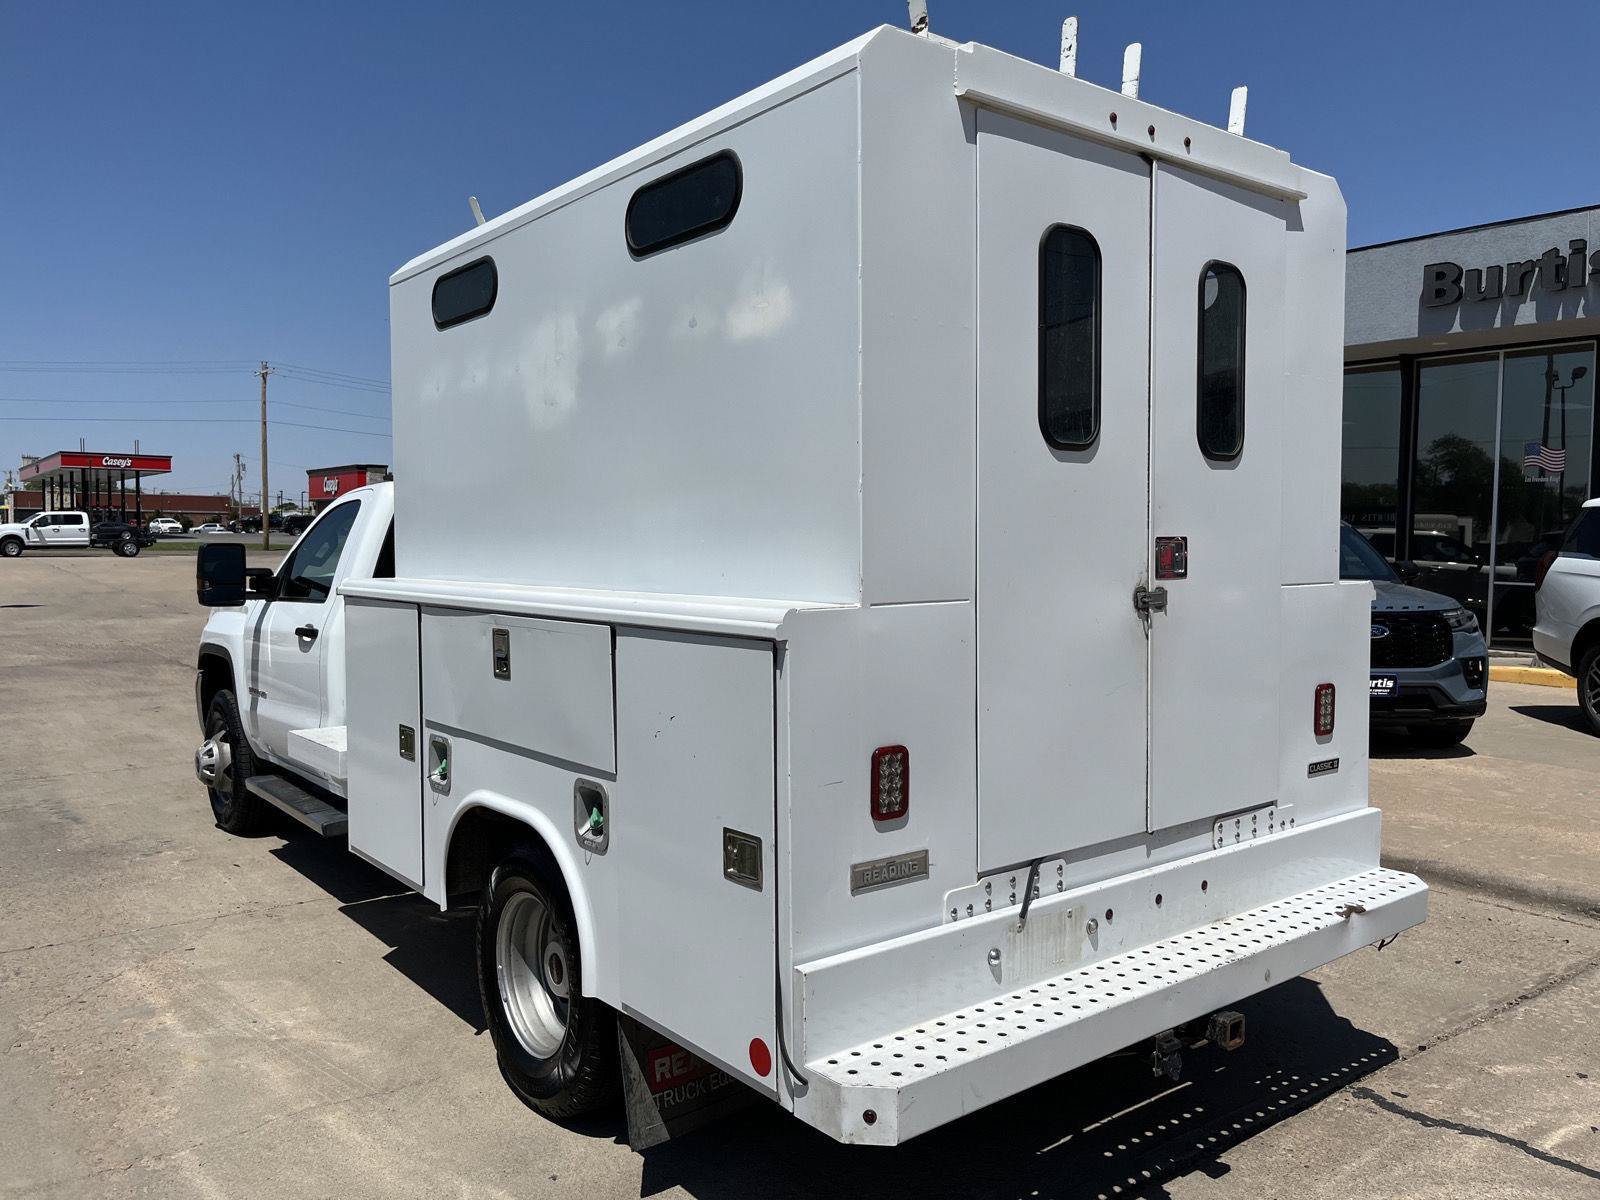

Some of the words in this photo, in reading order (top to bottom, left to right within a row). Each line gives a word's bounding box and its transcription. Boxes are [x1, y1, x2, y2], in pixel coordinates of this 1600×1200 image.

[102, 456, 132, 468] Casey's
[863, 861, 919, 885] READING
[652, 1080, 706, 1111] TRUCK
